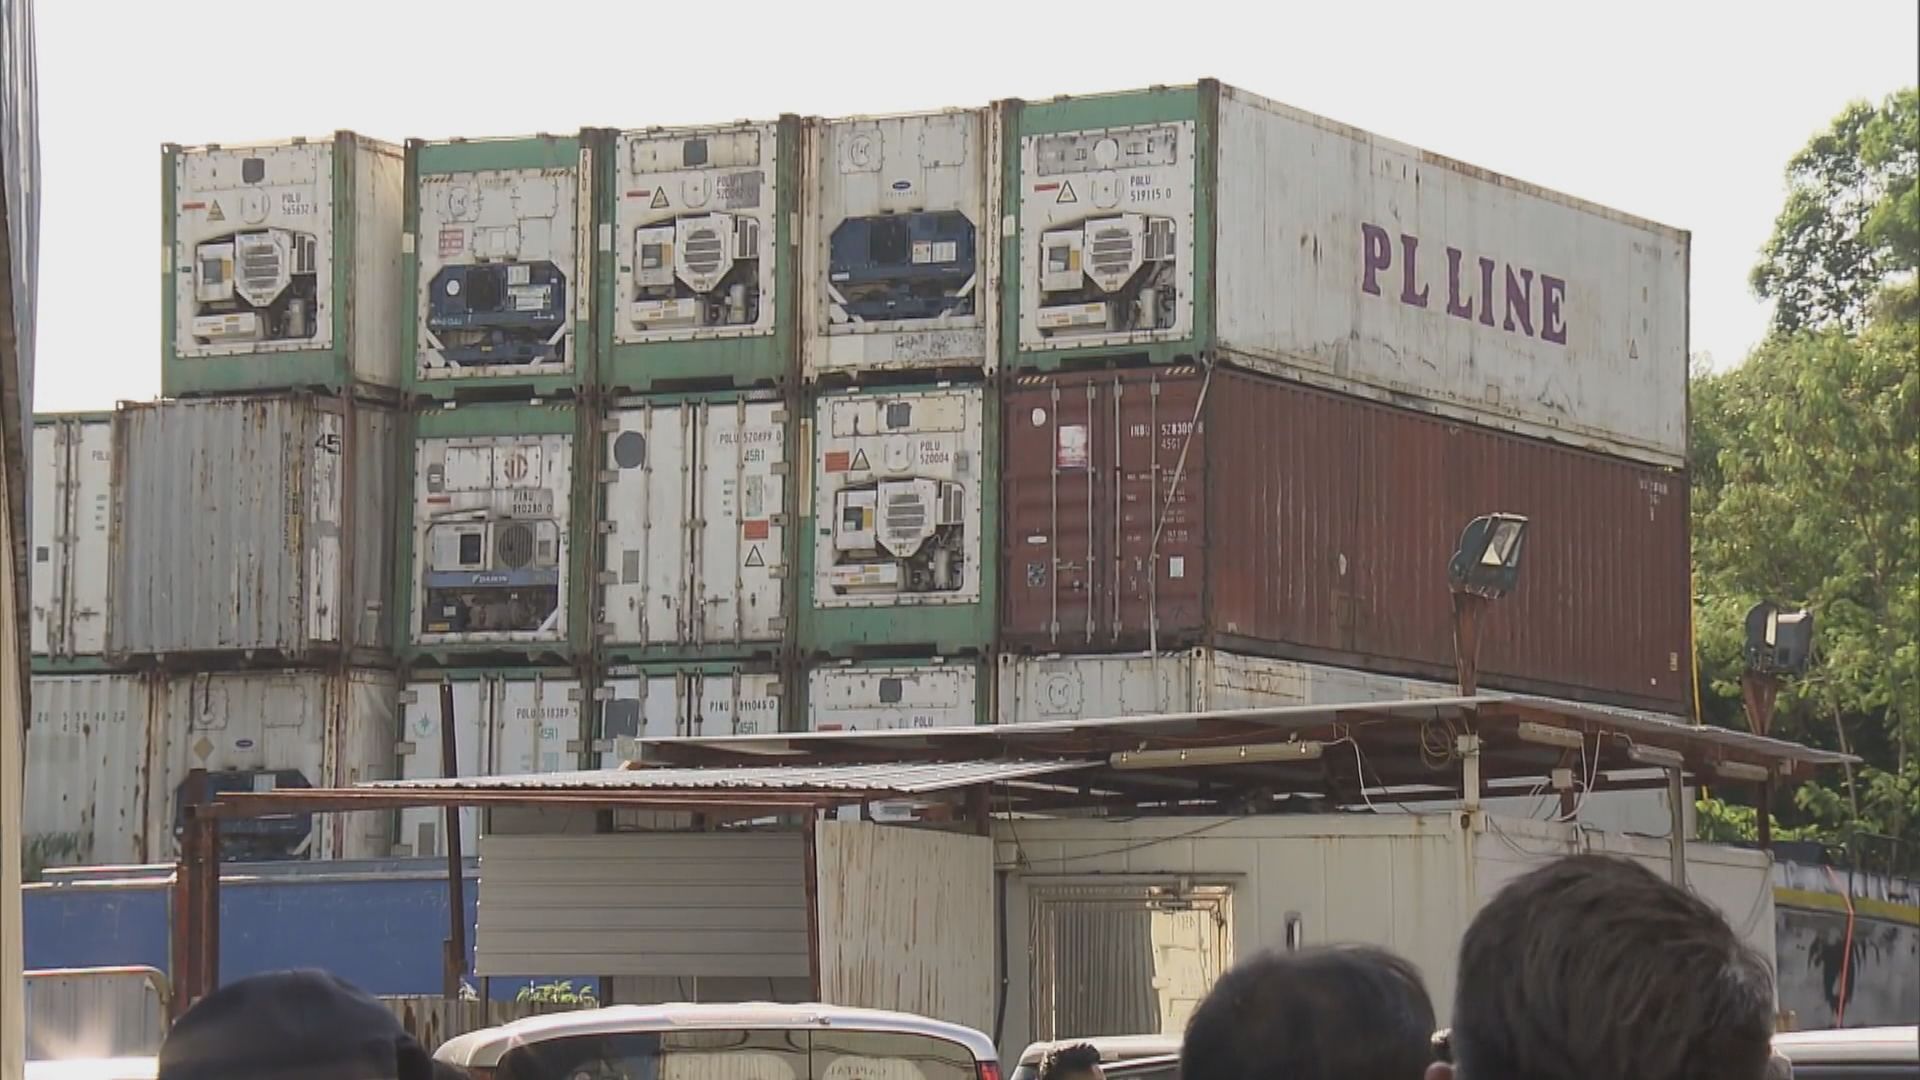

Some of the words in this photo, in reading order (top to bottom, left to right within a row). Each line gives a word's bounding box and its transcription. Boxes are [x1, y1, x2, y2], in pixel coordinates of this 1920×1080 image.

[1130, 175, 1151, 186] POLU
[281, 192, 301, 203] POLU
[1130, 188, 1161, 202] 519115
[1361, 222, 1429, 308] PL
[1446, 246, 1567, 345] LINE
[720, 433, 739, 443] POLU
[315, 433, 341, 455] 45
[920, 441, 940, 451] POLU
[710, 701, 729, 712] PINU
[516, 708, 536, 719] POLU
[913, 716, 934, 728] POLU
